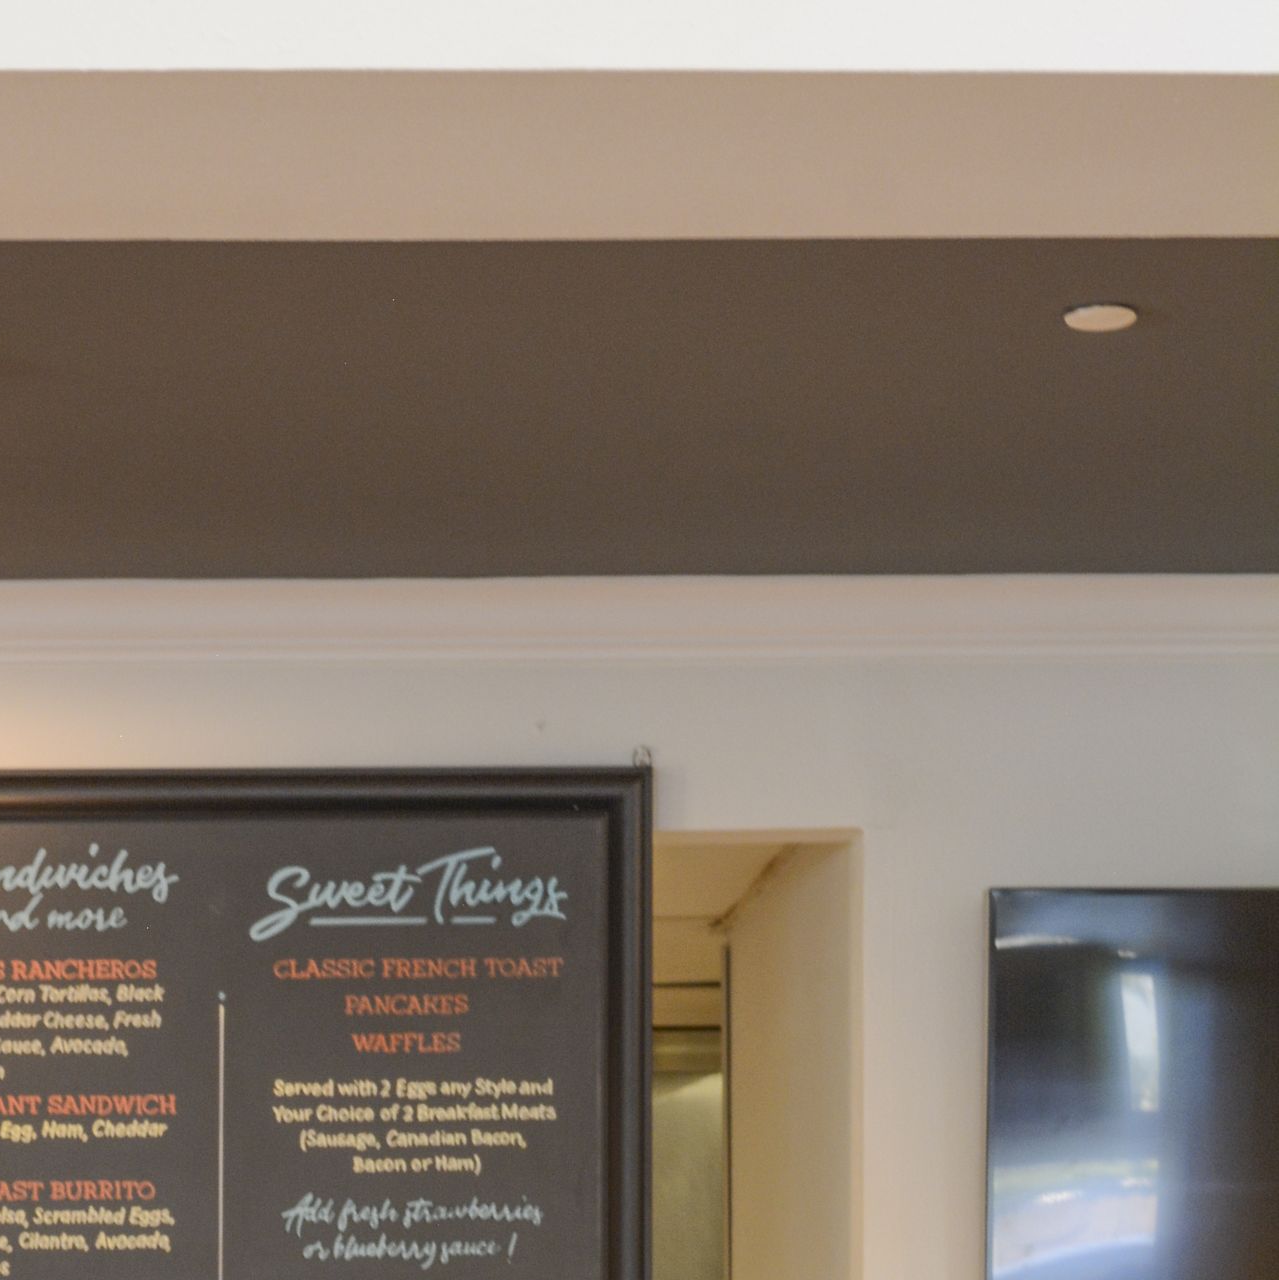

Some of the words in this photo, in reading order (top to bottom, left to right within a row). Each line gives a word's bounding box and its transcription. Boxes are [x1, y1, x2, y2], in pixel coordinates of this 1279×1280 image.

[249, 865, 422, 942] Sweet
[416, 846, 568, 927] Things
[46, 906, 128, 932] more
[11, 959, 158, 982] RANCHEROS
[273, 959, 375, 981] CLASSIC
[381, 958, 476, 979] FRENCH
[484, 957, 565, 979] TOAST
[344, 994, 469, 1015] PANCAKES
[351, 1032, 461, 1054] WAFFLES
[47, 1094, 177, 1117] SANDWICH
[50, 1179, 156, 1201] BURRITO
